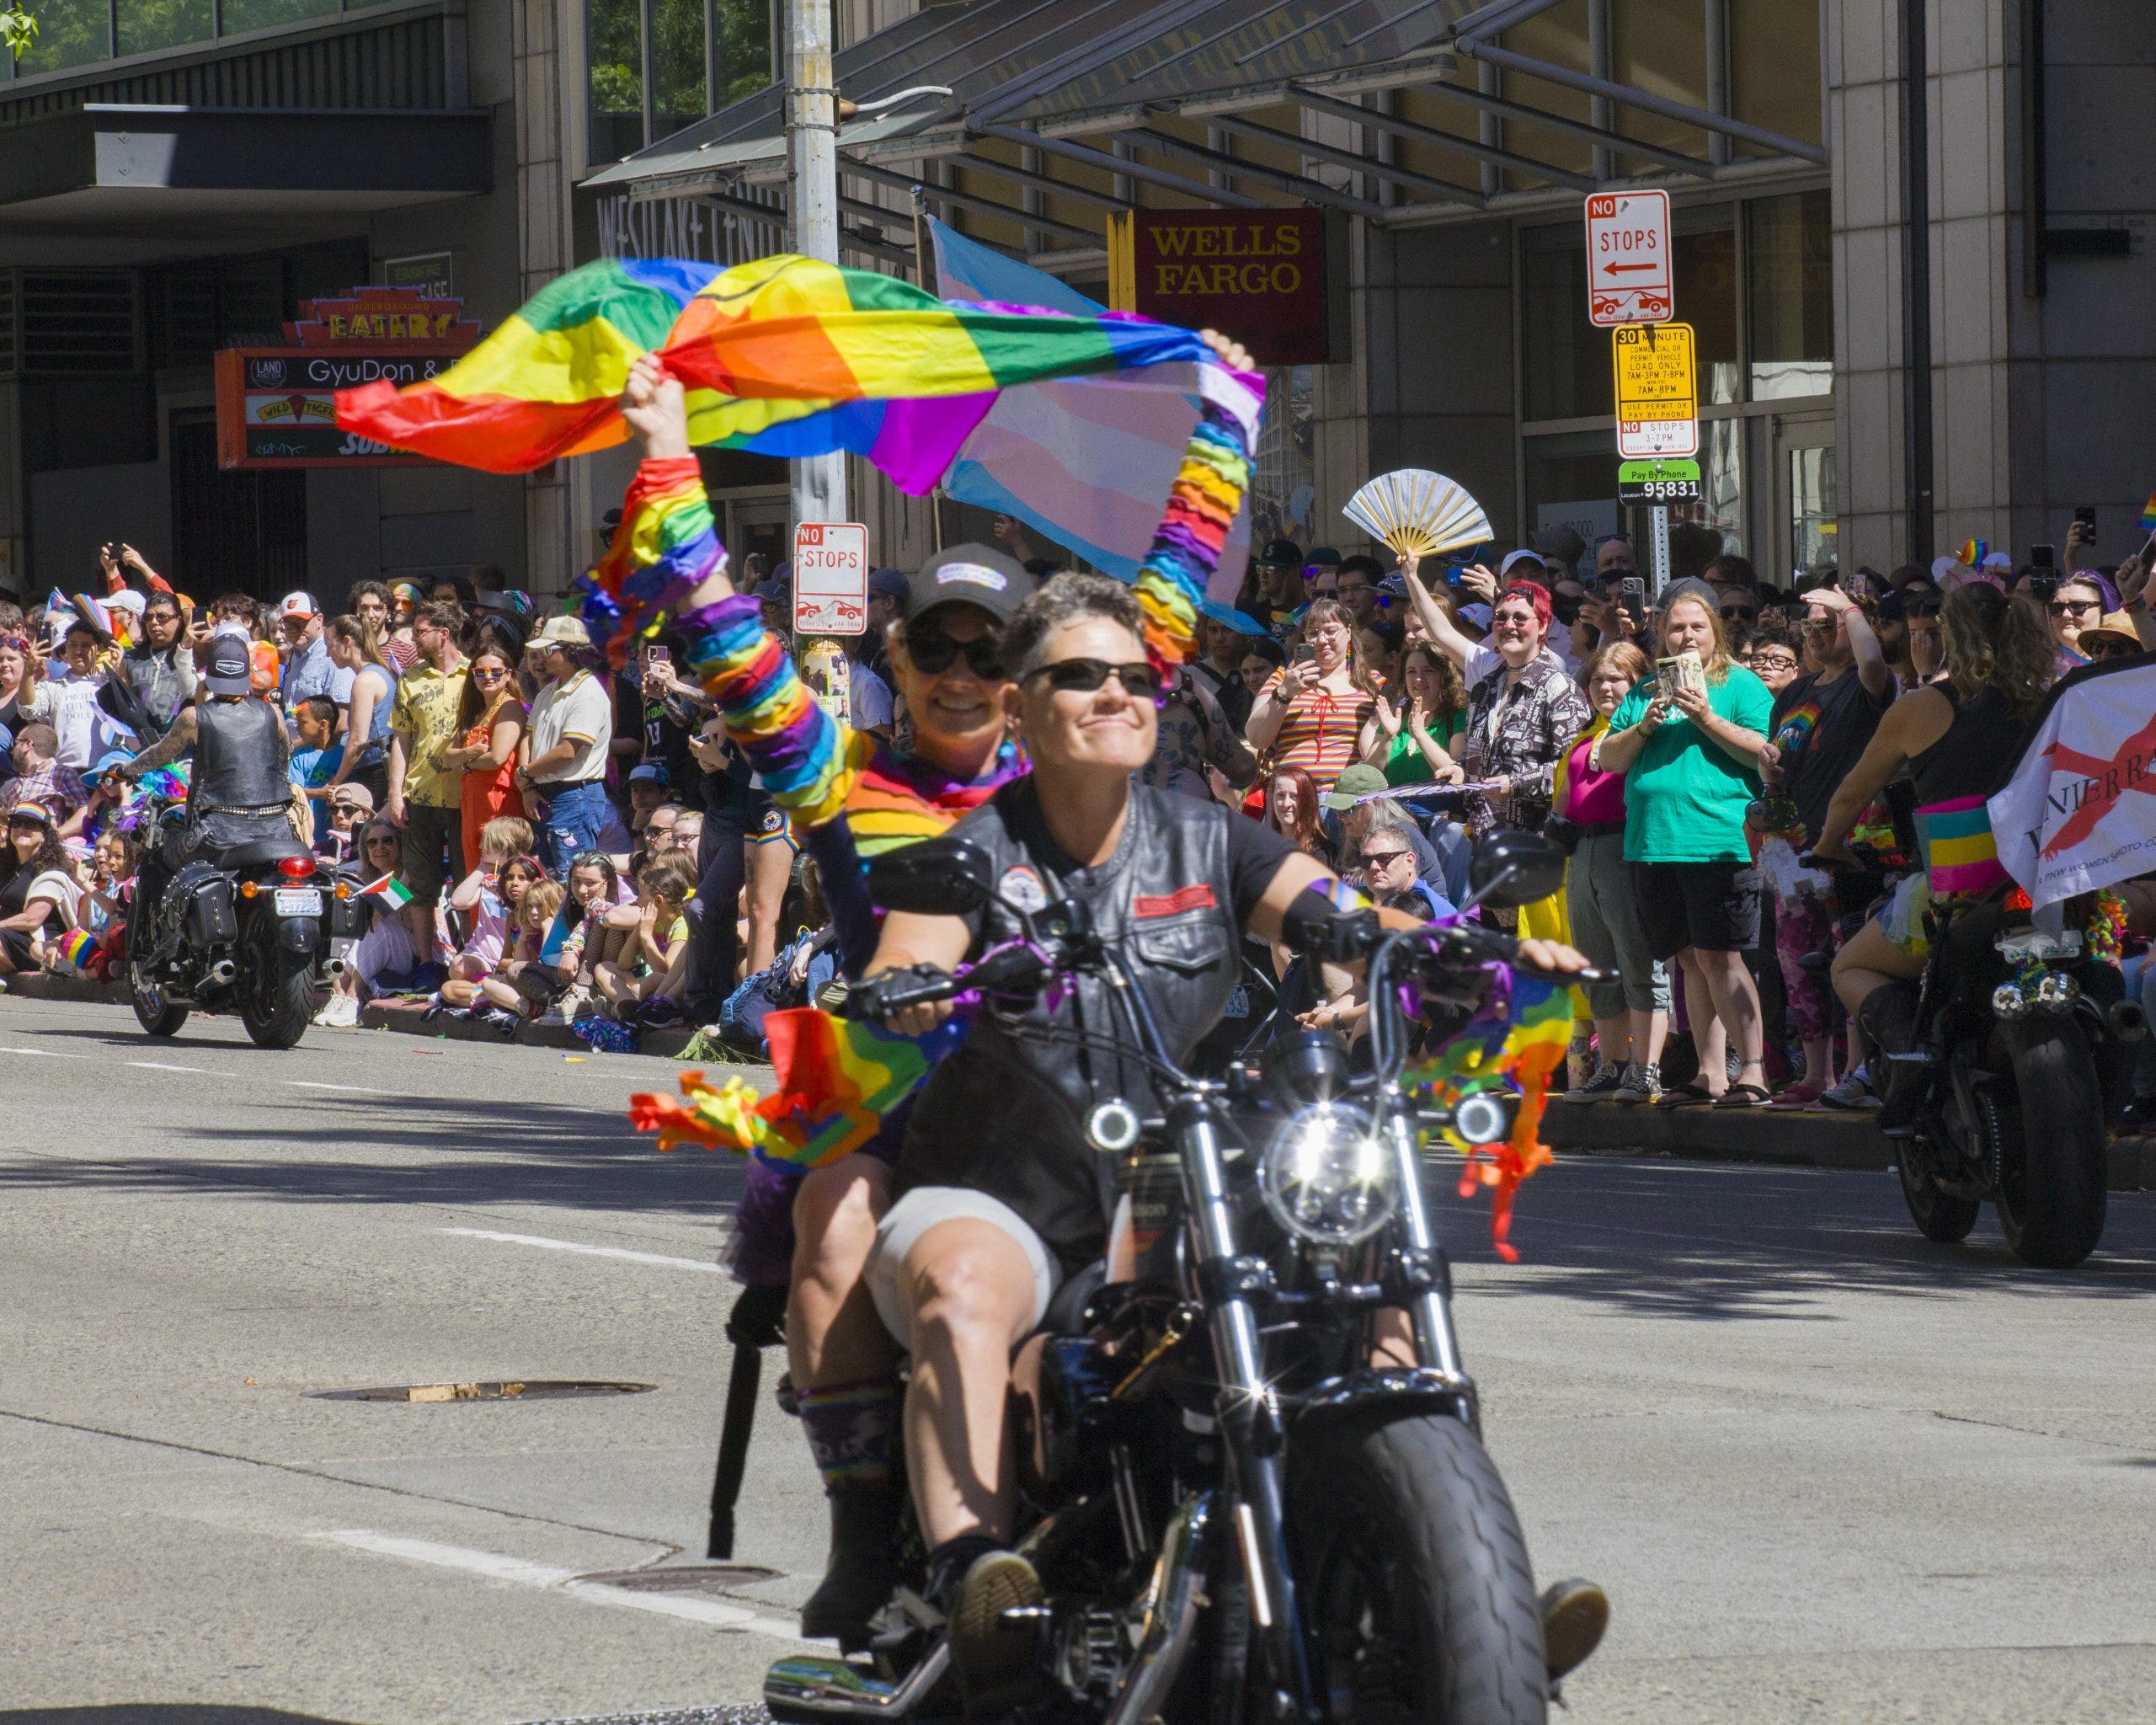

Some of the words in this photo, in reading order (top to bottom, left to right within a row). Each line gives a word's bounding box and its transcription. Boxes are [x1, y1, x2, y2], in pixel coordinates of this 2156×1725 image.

[1593, 200, 1614, 216] NO
[1149, 225, 1301, 256] WELLS
[1600, 229, 1657, 253] STOPS
[1154, 263, 1301, 295] FARGO
[420, 280, 448, 298] EASE
[330, 314, 453, 339] EATERY
[1619, 330, 1636, 344] 30
[1642, 332, 1686, 342] MNUTE
[1630, 345, 1670, 354] COMMECIAL
[256, 360, 282, 374] LAND
[308, 359, 415, 386] GyuDon
[424, 360, 440, 380] &
[1627, 371, 1660, 381] 7AM-3PM
[264, 403, 291, 419] WILD
[1623, 421, 1638, 432] NO
[1650, 422, 1684, 432] STOPS
[338, 432, 414, 455] SUB
[1631, 471, 1646, 480] Pay
[1648, 470, 1659, 480] By
[1661, 470, 1687, 478] Phone
[801, 528, 819, 542] NO
[804, 550, 857, 568] STOPS
[2044, 868, 2068, 884] PNW
